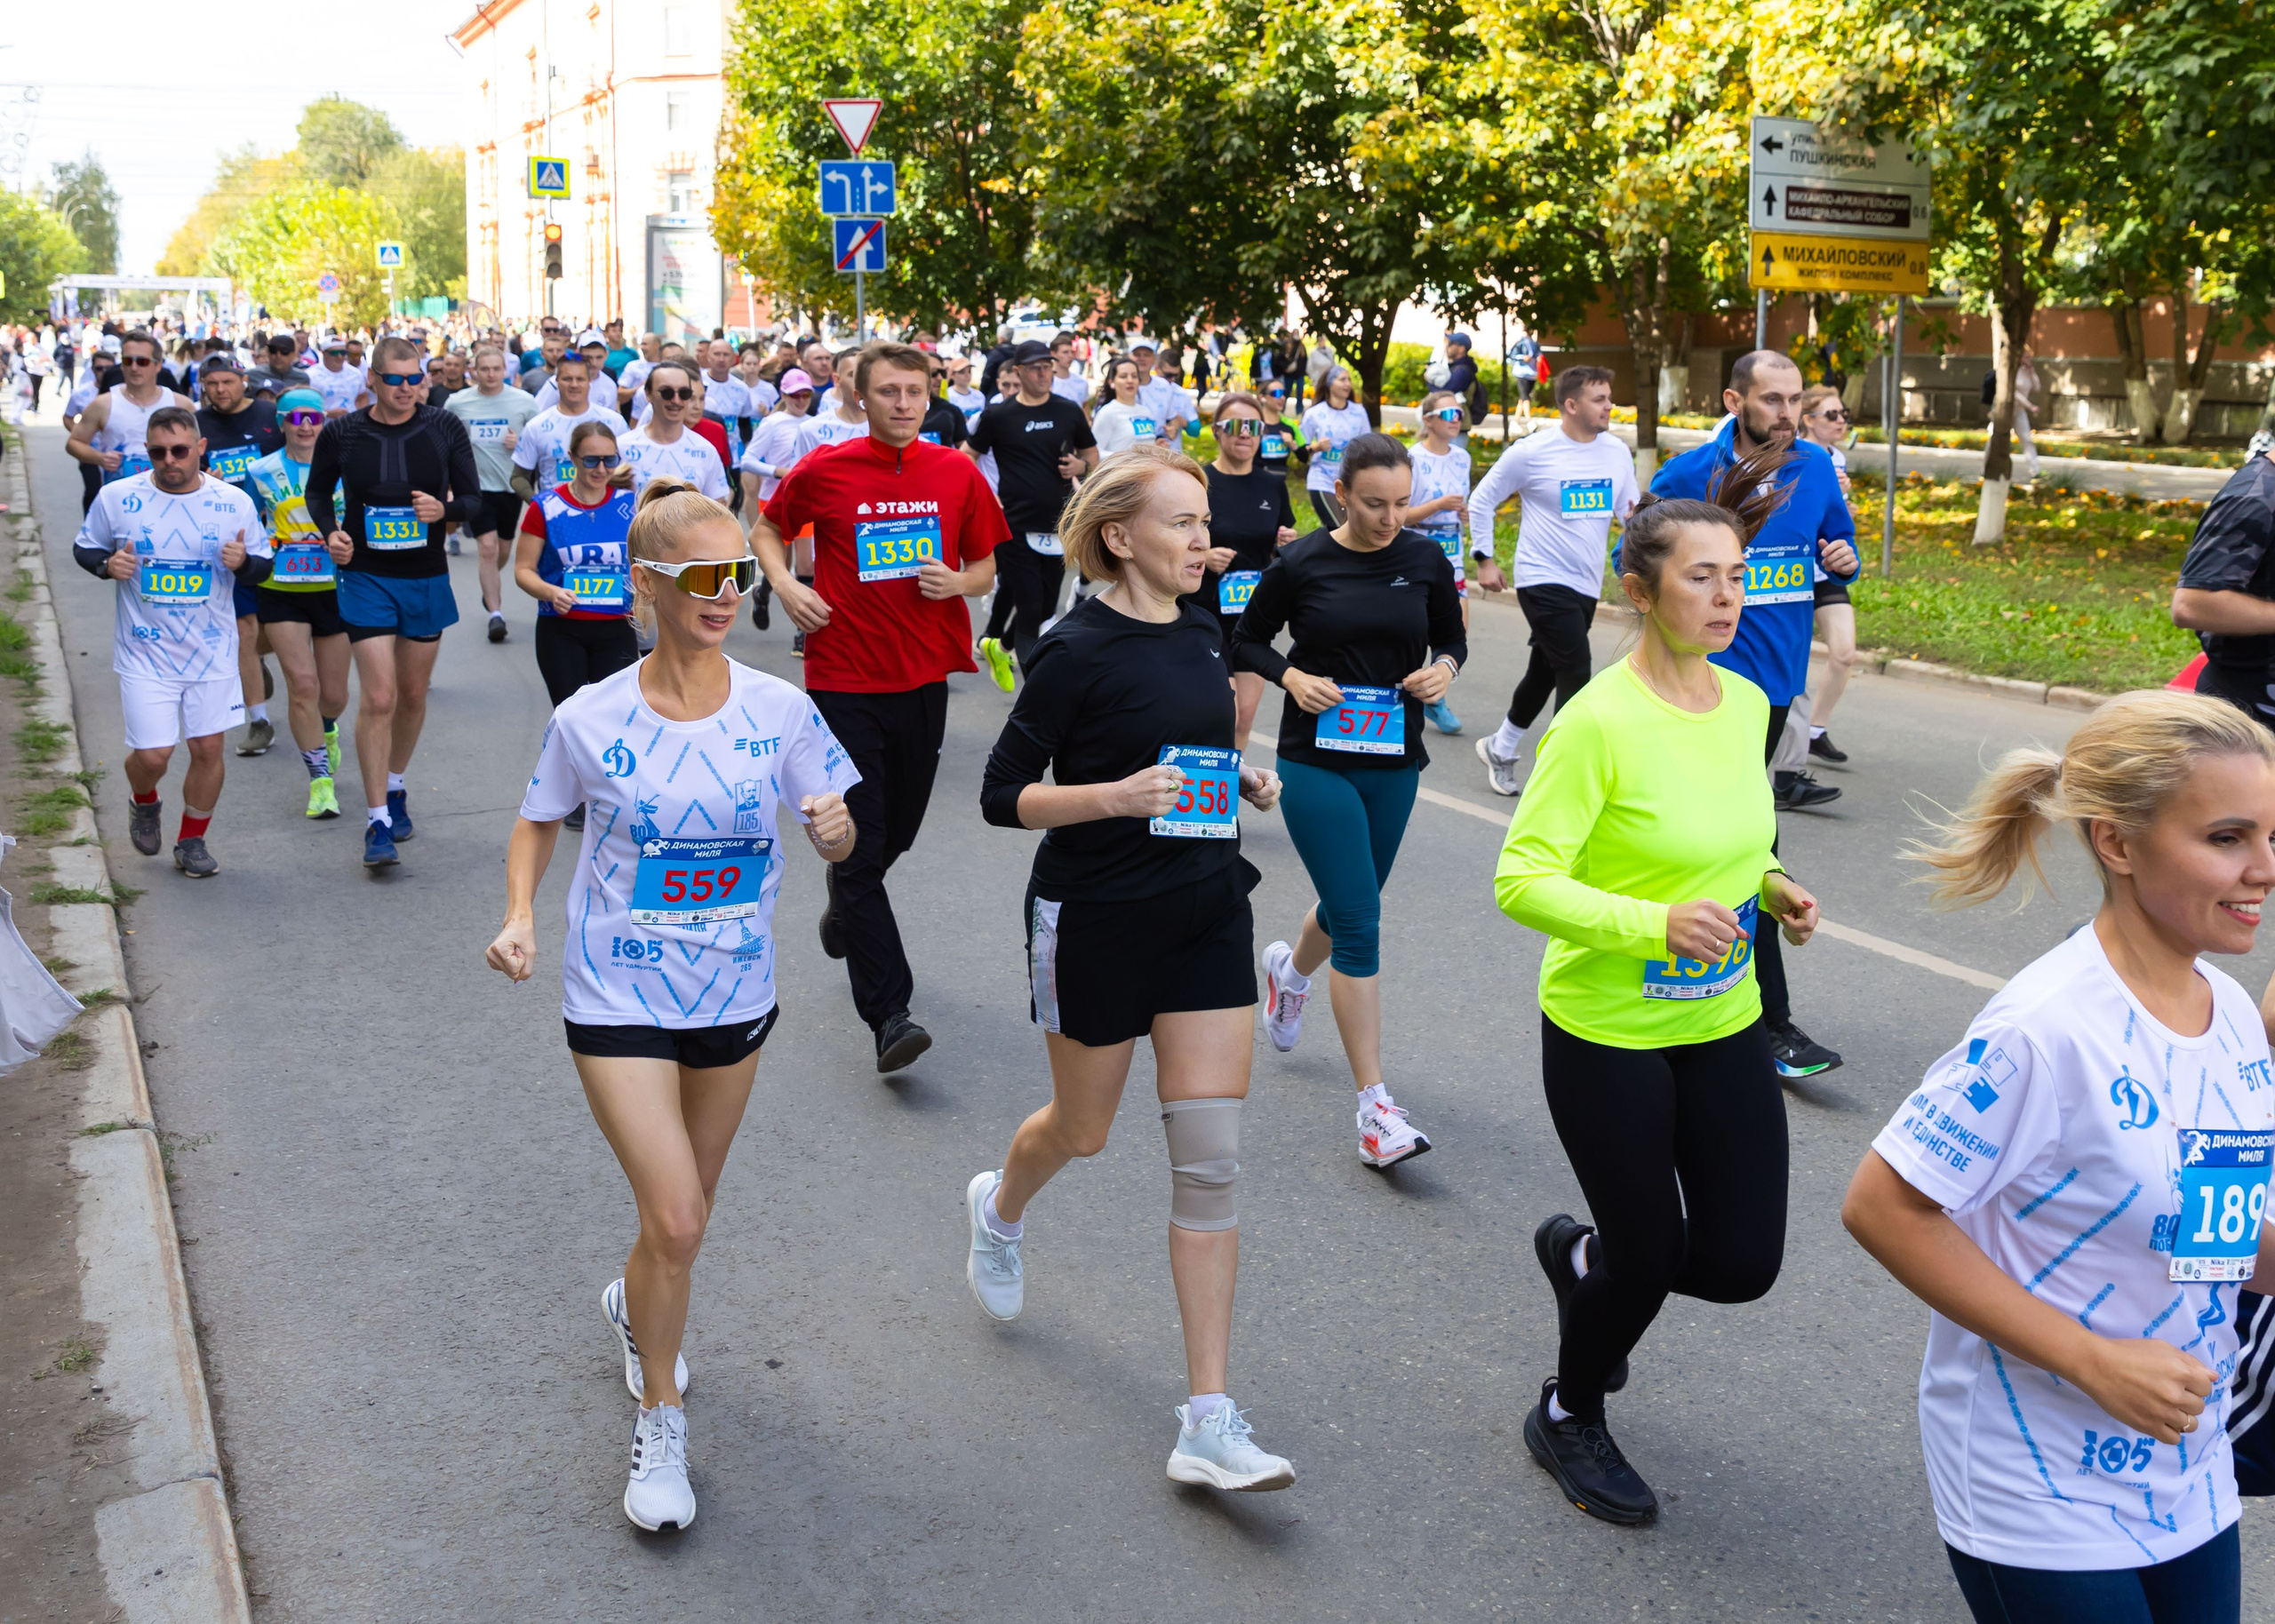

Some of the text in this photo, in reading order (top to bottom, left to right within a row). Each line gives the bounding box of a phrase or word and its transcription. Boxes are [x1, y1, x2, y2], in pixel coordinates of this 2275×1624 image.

[1789, 149, 1877, 169] ПУШКИНСКАЯ
[1783, 245, 1907, 267] МИХАЙЛОВСКИЙ
[478, 427, 501, 438] 237
[214, 502, 236, 513] ВТБ
[1569, 492, 1605, 508] 1131
[373, 521, 420, 538] 1331
[557, 540, 627, 567] URA
[866, 537, 933, 565] 1330
[286, 556, 323, 573] 653
[148, 573, 204, 593] 1019
[1747, 563, 1806, 590] 1268
[573, 577, 615, 594] 1177
[1227, 585, 1255, 602] 127
[1337, 708, 1391, 736] 577
[1180, 748, 1229, 760] ДИНАМОВСКАЯ
[1199, 758, 1219, 768] МИЛЯ
[1174, 778, 1229, 816] 558
[739, 811, 758, 832] 185
[629, 824, 647, 839] 80
[670, 840, 746, 850] ДИНАМОВСКАЯ
[693, 849, 722, 858] МИЛЯ
[661, 865, 741, 903] 559
[625, 963, 662, 972] УДМУРТИИ
[732, 953, 762, 965] ИЖЕВСК
[739, 963, 753, 973] 265
[1926, 1103, 1937, 1119] В
[1932, 1111, 2001, 1161] ДВИЖЕНИИ
[1912, 1120, 1973, 1173] ЕДИНСТВЕ
[2238, 1150, 2265, 1163] МИЛЯ
[2192, 1182, 2267, 1244] 189
